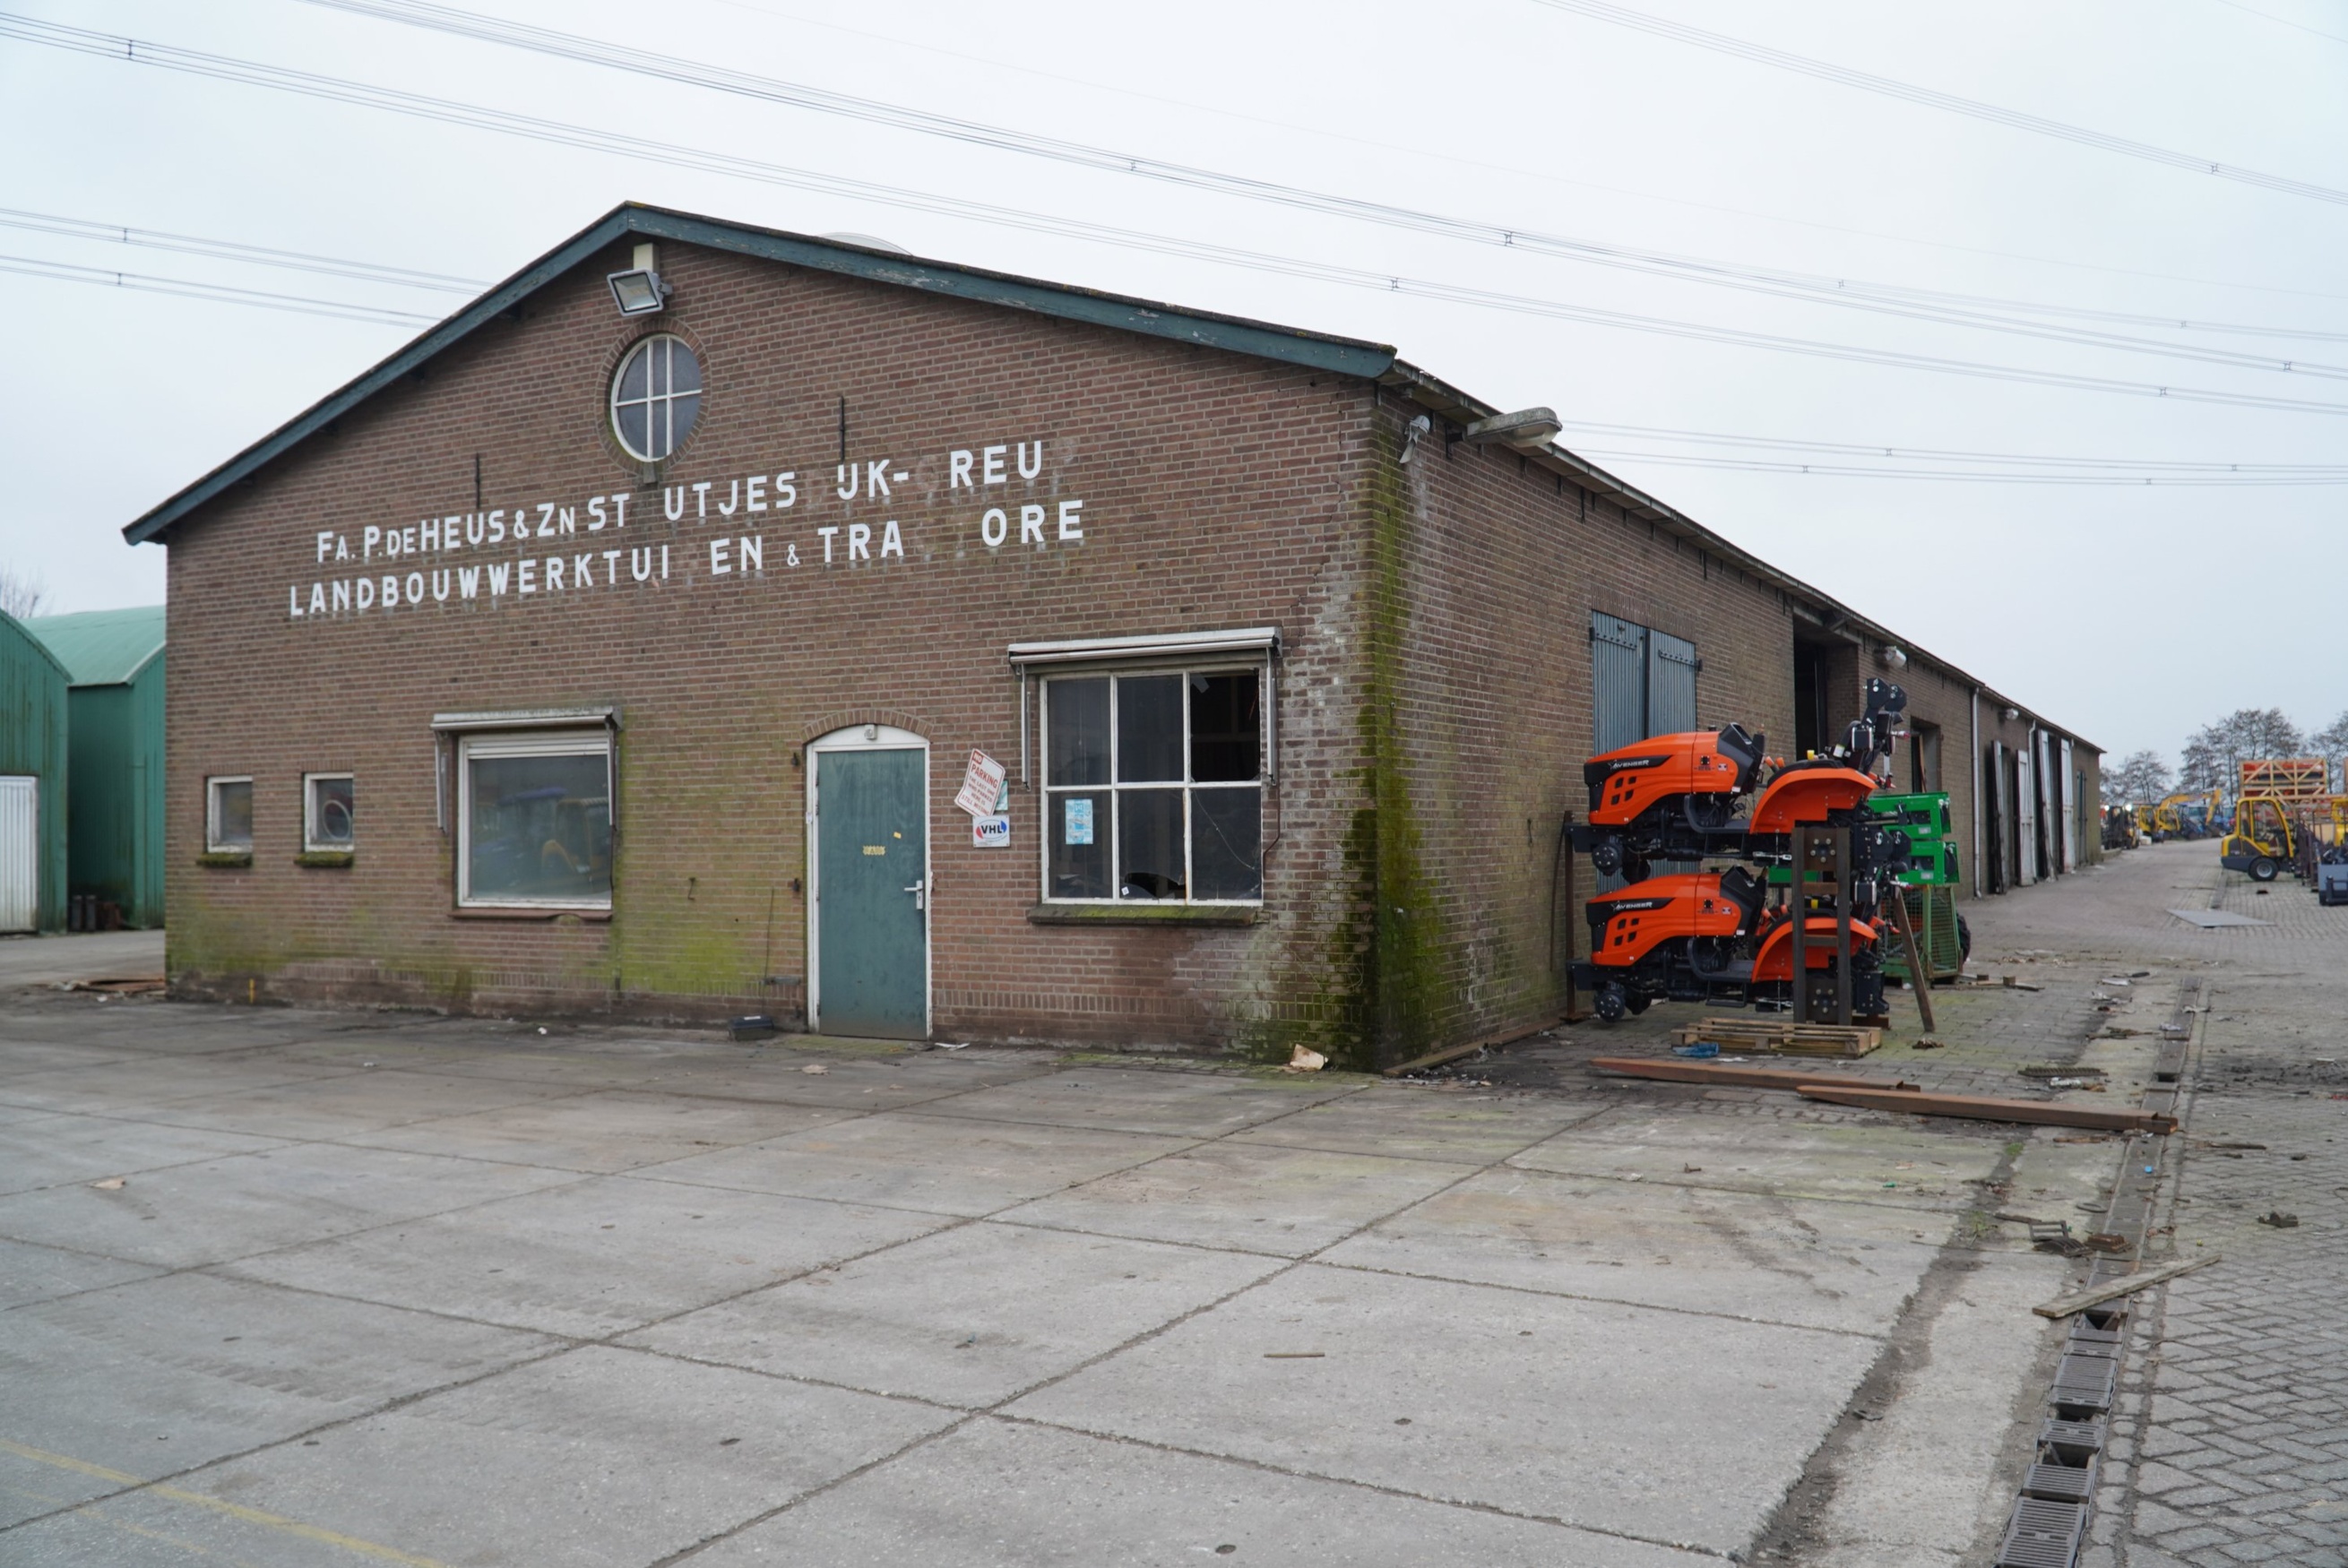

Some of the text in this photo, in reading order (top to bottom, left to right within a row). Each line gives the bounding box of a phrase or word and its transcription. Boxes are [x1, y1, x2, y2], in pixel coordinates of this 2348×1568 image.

[420, 510, 505, 552] HEUS
[514, 510, 530, 539] &
[786, 543, 800, 566] &
[973, 753, 982, 763] NO
[1613, 759, 1650, 769] AVENGER
[971, 763, 998, 788] PARKING
[977, 780, 987, 791] LAST
[961, 794, 973, 806] STILL
[980, 824, 1002, 834] VHL
[1615, 901, 1653, 911] AVENGER
